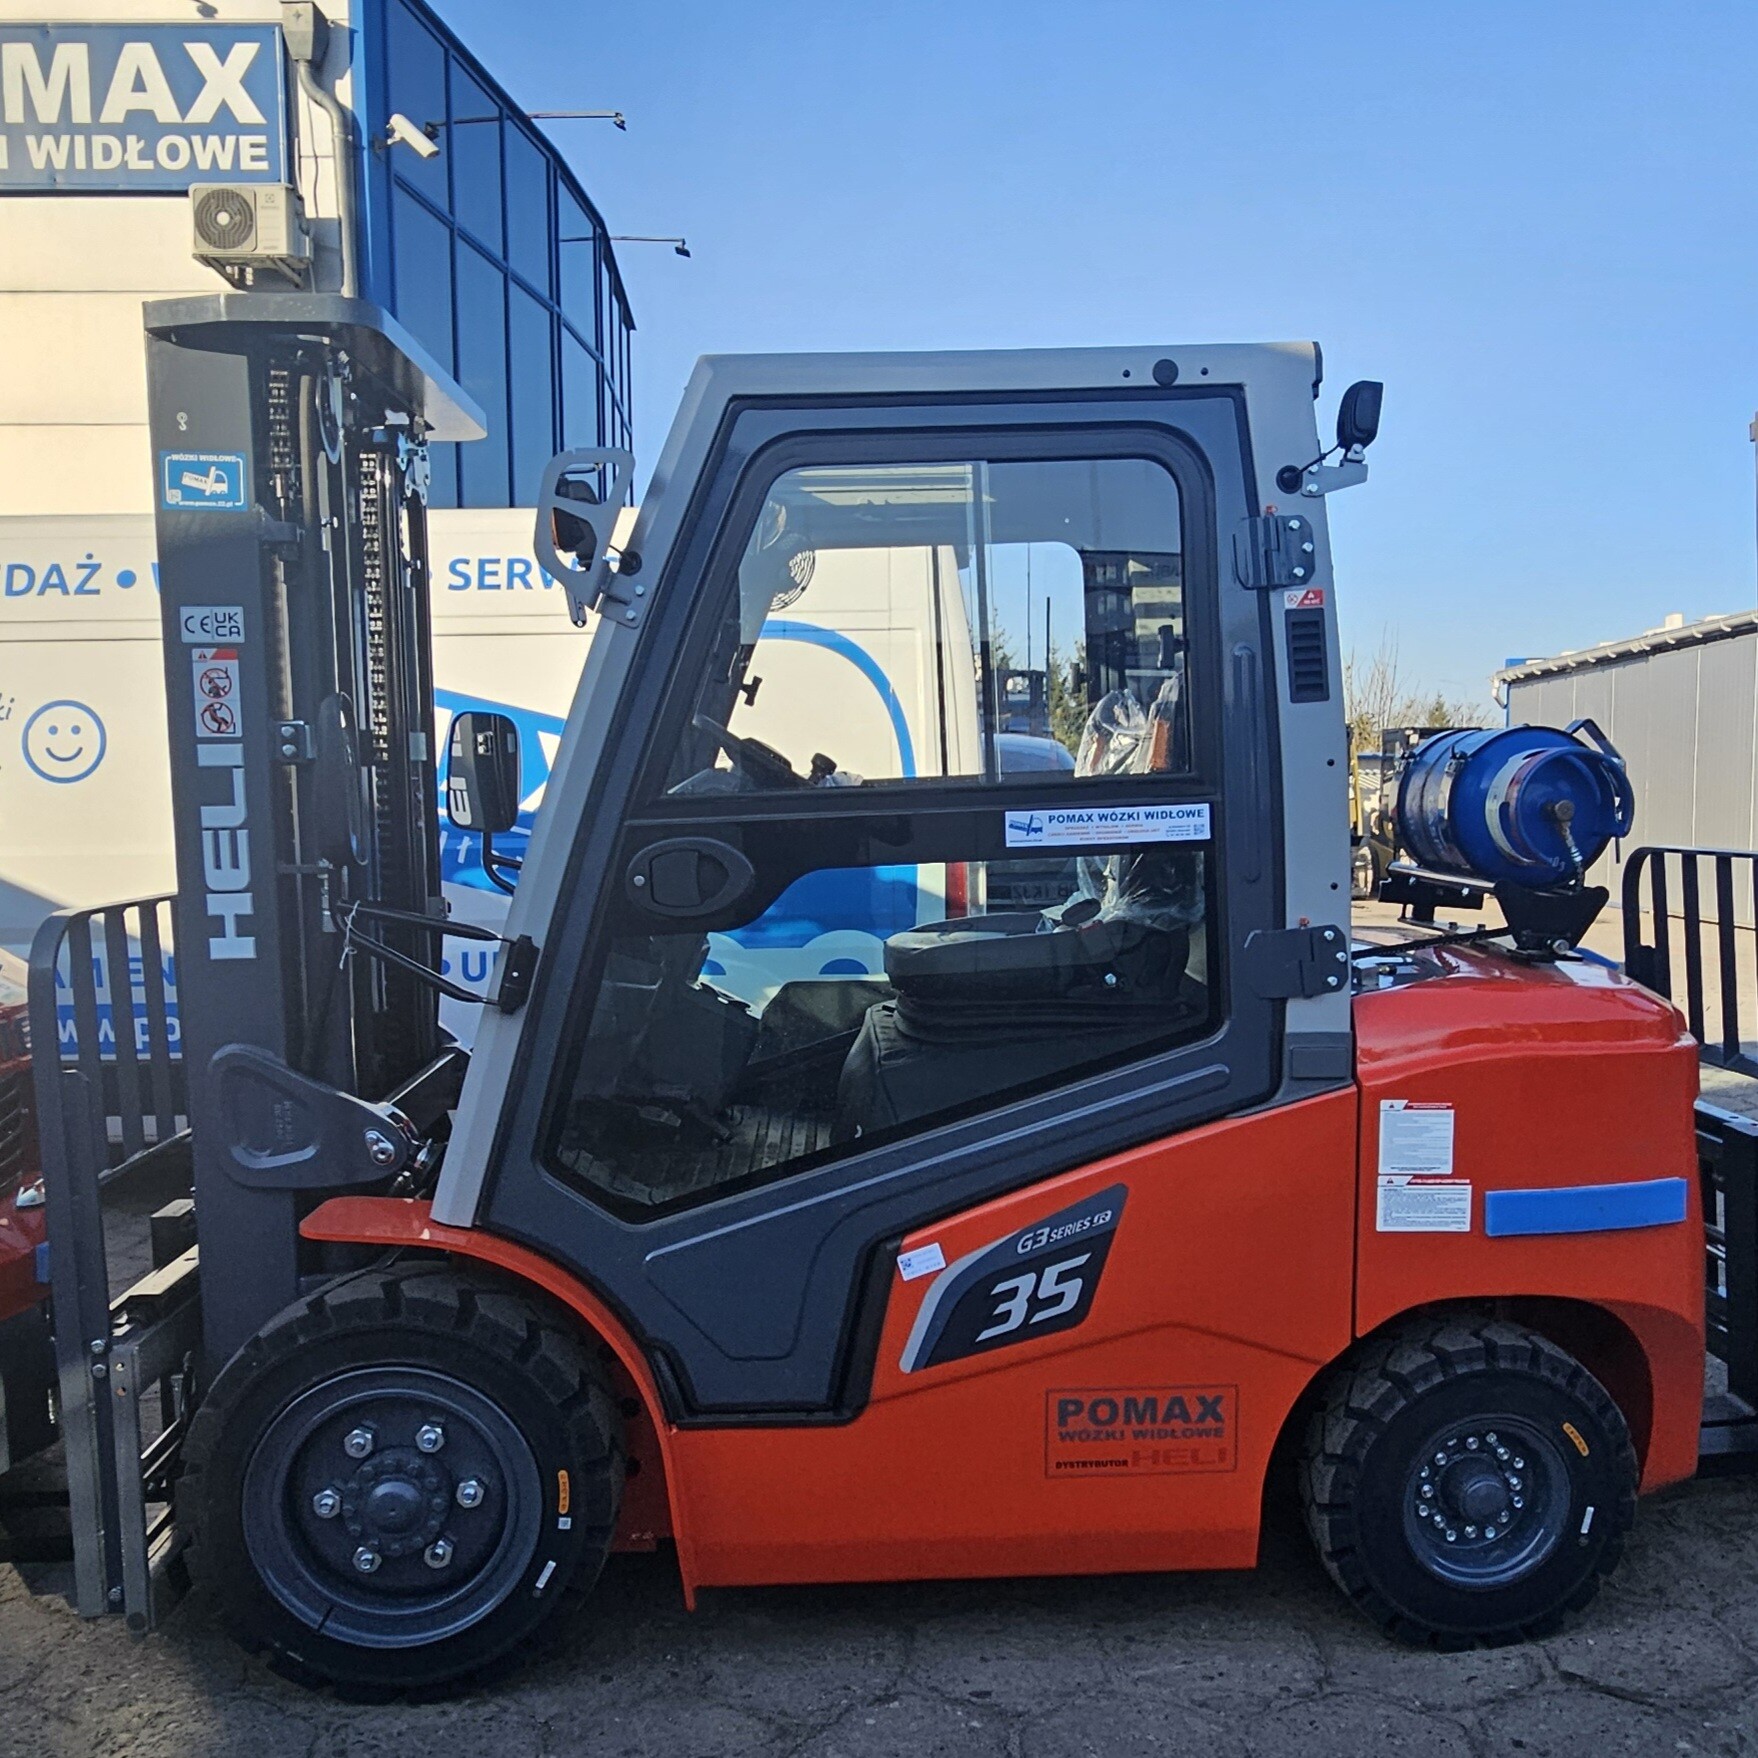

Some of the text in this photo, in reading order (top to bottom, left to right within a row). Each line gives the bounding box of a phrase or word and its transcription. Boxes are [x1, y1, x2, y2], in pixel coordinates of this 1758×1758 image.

[1, 42, 268, 124] MAX
[25, 135, 270, 171] WIDŁOWE
[1048, 809, 1205, 824] POMAX WÓZKI WIDŁOWE
[196, 743, 257, 960] HELI
[1017, 1227, 1050, 1254] G3
[1050, 1216, 1091, 1243] SERIES
[975, 1252, 1092, 1342] 35
[1057, 1395, 1225, 1427] POMAX
[1059, 1428, 1224, 1442] WÓZKI WIDŁOWE
[1055, 1448, 1226, 1469] DYSTRYBUTOR HELI
